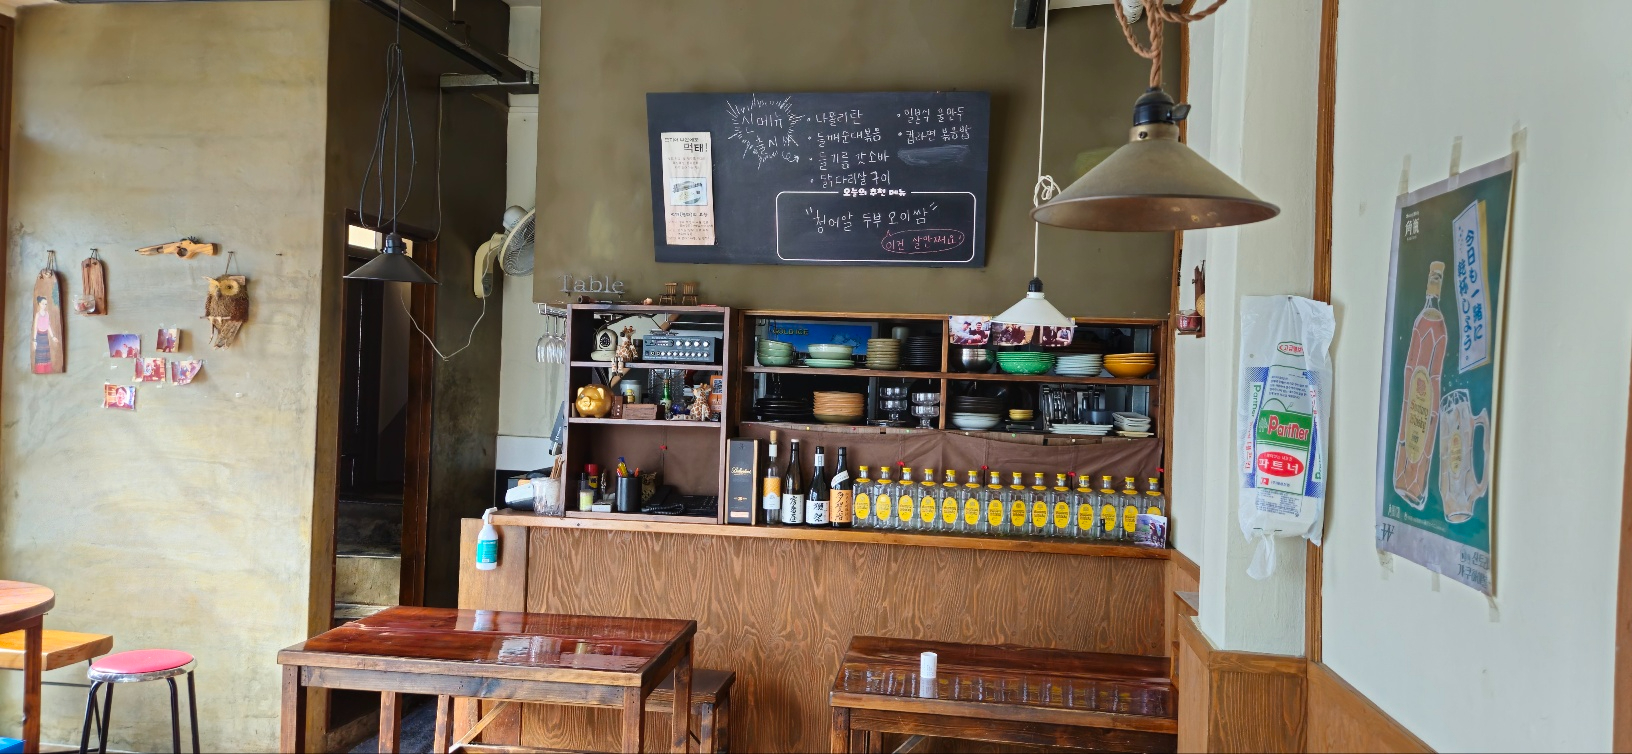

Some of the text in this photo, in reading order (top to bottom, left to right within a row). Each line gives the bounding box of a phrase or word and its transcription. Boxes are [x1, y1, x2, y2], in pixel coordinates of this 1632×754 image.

[843, 187, 907, 198] 오늘의 추천 메뉴
[559, 274, 625, 294] Table
[1258, 458, 1299, 474] 파트너
